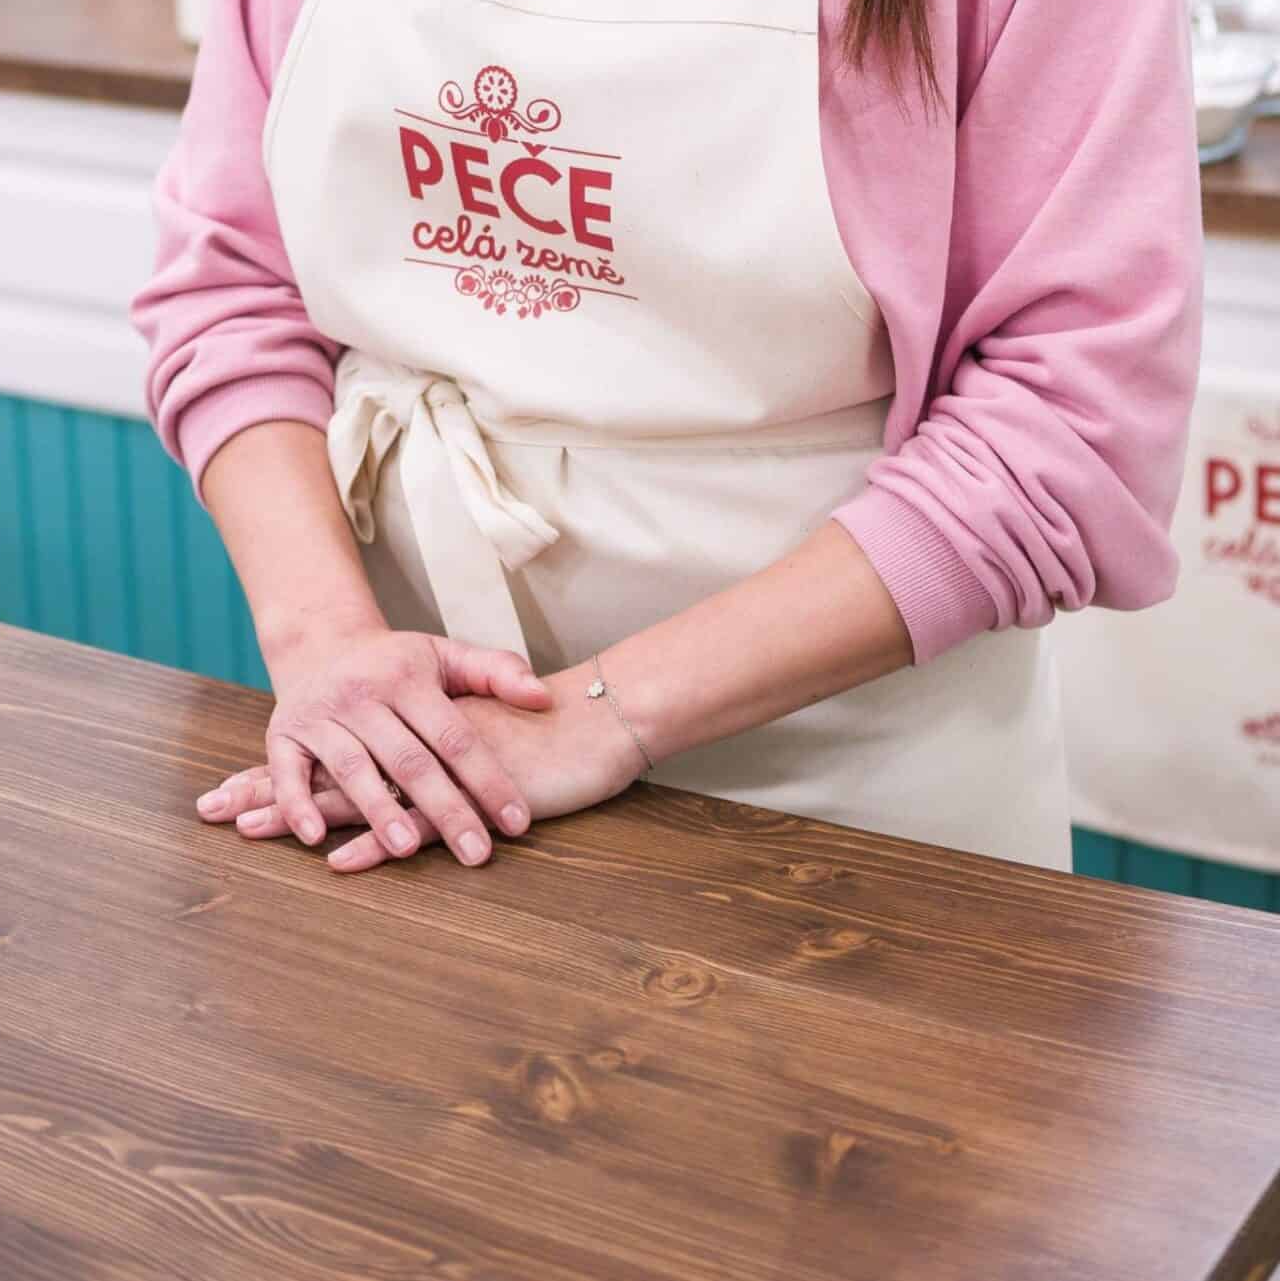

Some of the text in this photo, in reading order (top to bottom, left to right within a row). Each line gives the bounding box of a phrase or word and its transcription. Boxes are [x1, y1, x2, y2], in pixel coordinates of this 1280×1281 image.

[399, 126, 615, 253] PEČE
[412, 214, 626, 286] celá země
